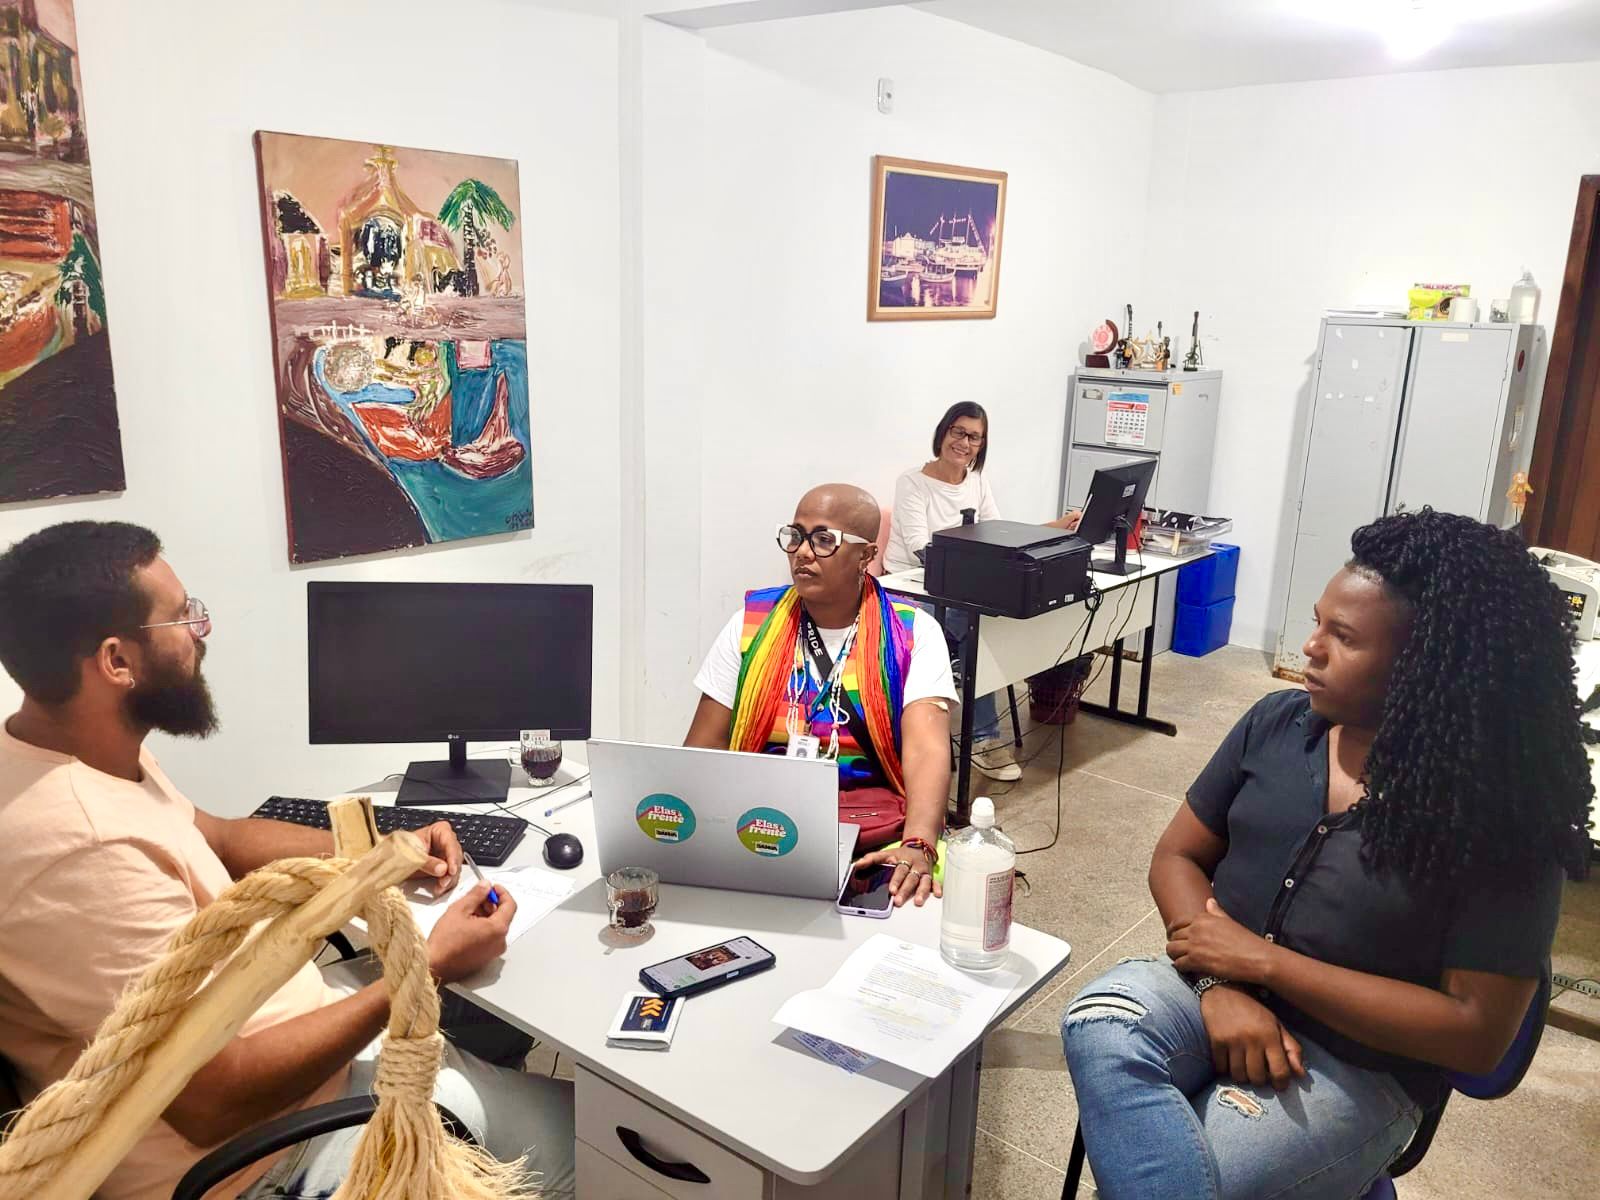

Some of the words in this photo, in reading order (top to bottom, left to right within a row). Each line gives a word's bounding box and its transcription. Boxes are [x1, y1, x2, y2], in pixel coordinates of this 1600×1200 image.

[807, 621, 824, 657] PRIDE
[653, 805, 677, 815] Elas
[647, 811, 685, 824] frente
[755, 818, 779, 829] Elas
[748, 824, 787, 838] frente
